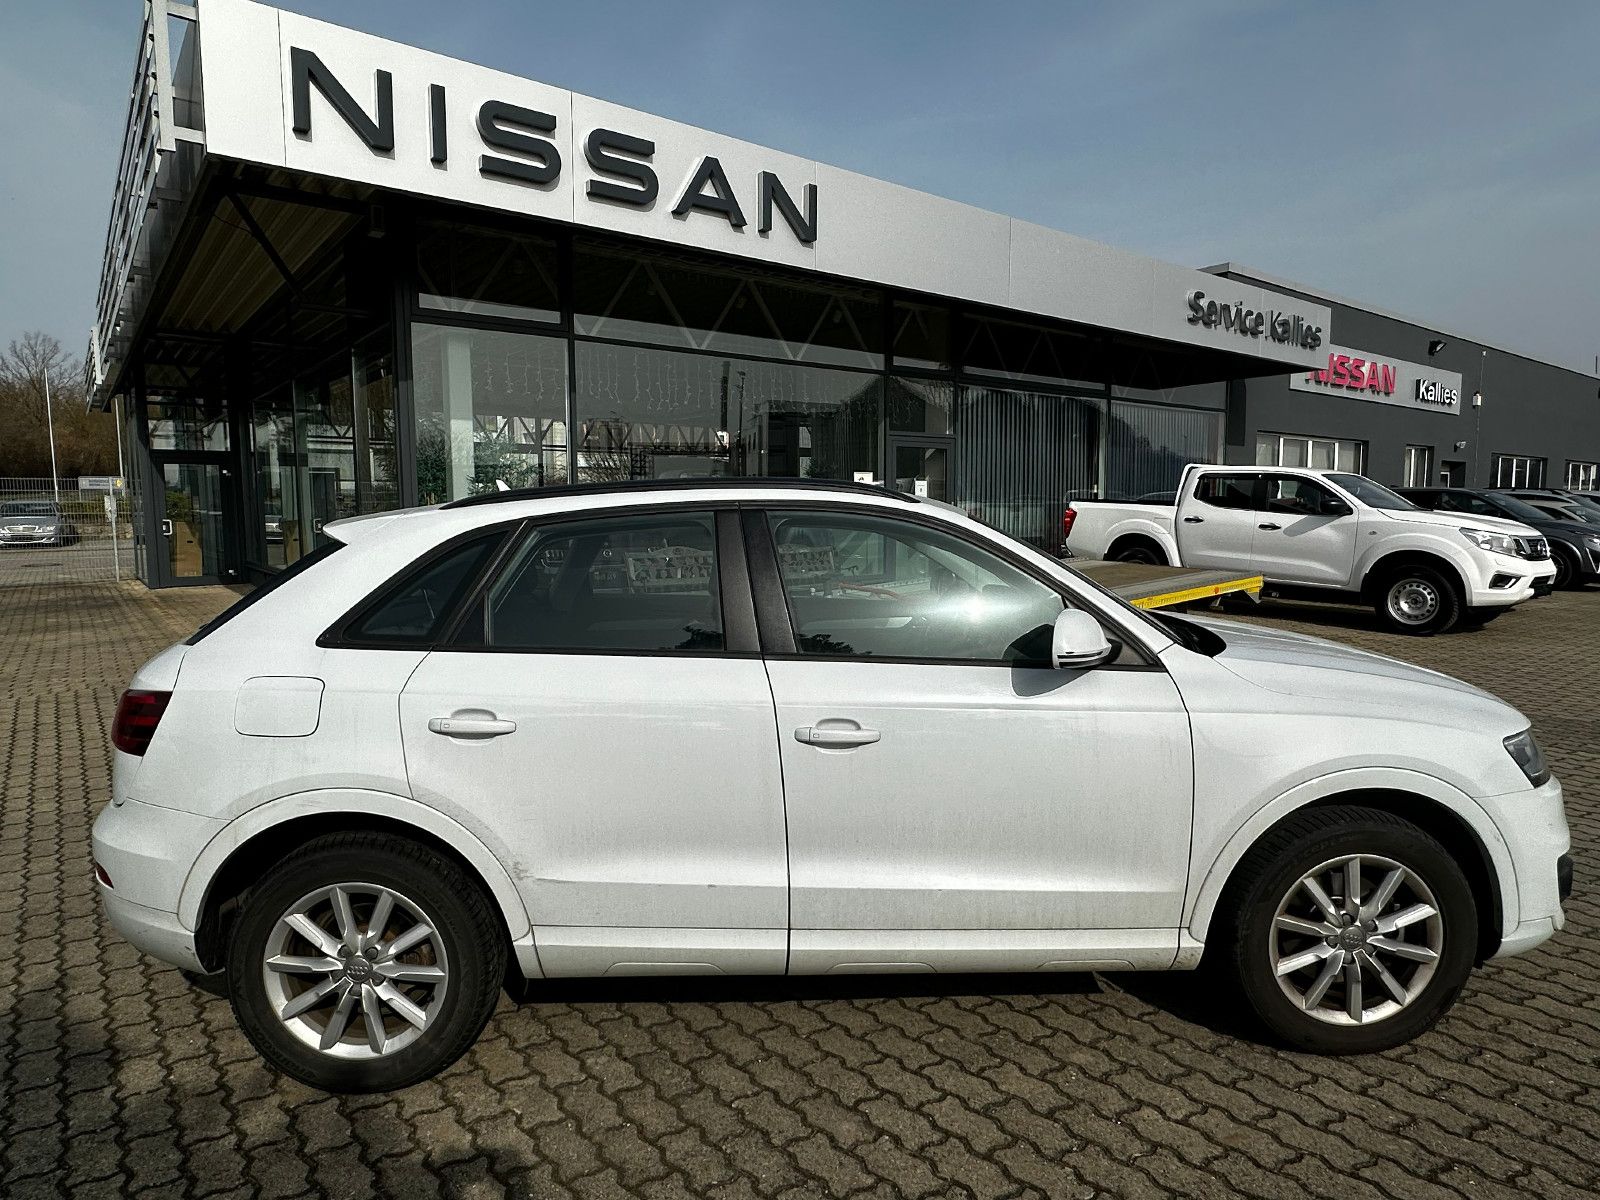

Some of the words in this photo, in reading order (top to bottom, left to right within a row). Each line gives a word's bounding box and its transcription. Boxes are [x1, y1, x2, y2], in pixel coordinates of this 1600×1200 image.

[290, 46, 818, 243] NISSAN
[1187, 290, 1264, 339] Service
[1265, 310, 1322, 351] Kallies
[1418, 378, 1458, 405] Kallies
